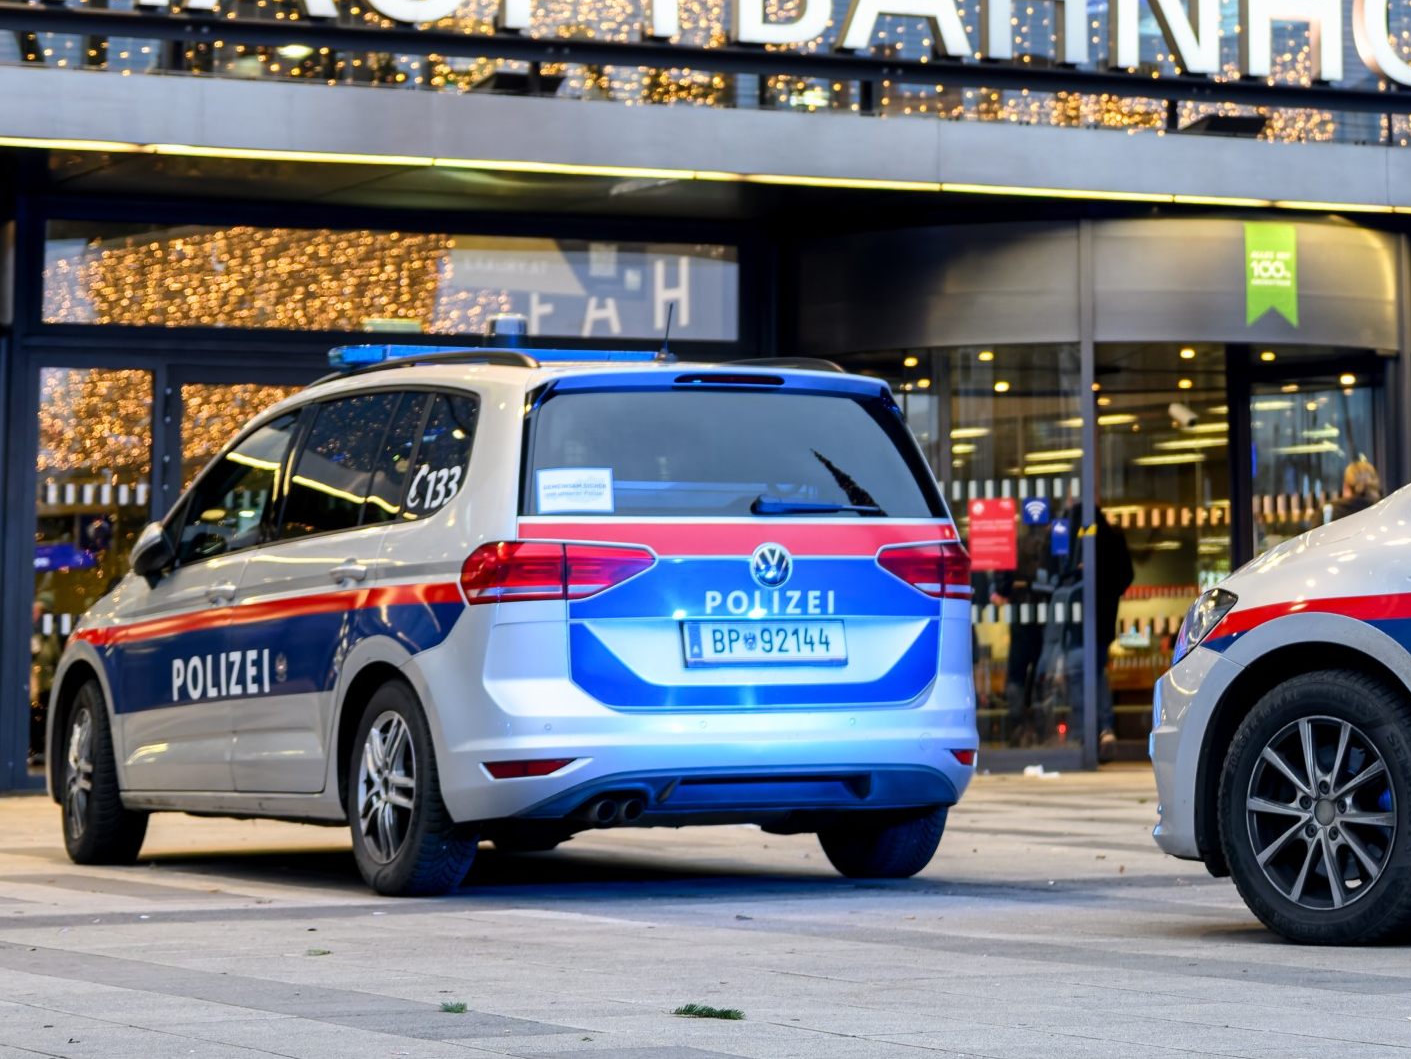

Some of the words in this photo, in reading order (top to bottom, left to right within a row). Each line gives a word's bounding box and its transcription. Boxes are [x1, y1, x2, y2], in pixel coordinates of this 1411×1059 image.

[424, 465, 462, 510] 133
[705, 590, 835, 614] POLIZEI
[712, 628, 740, 654] BP
[760, 627, 831, 654] 92144
[172, 648, 271, 702] POLIZEI
